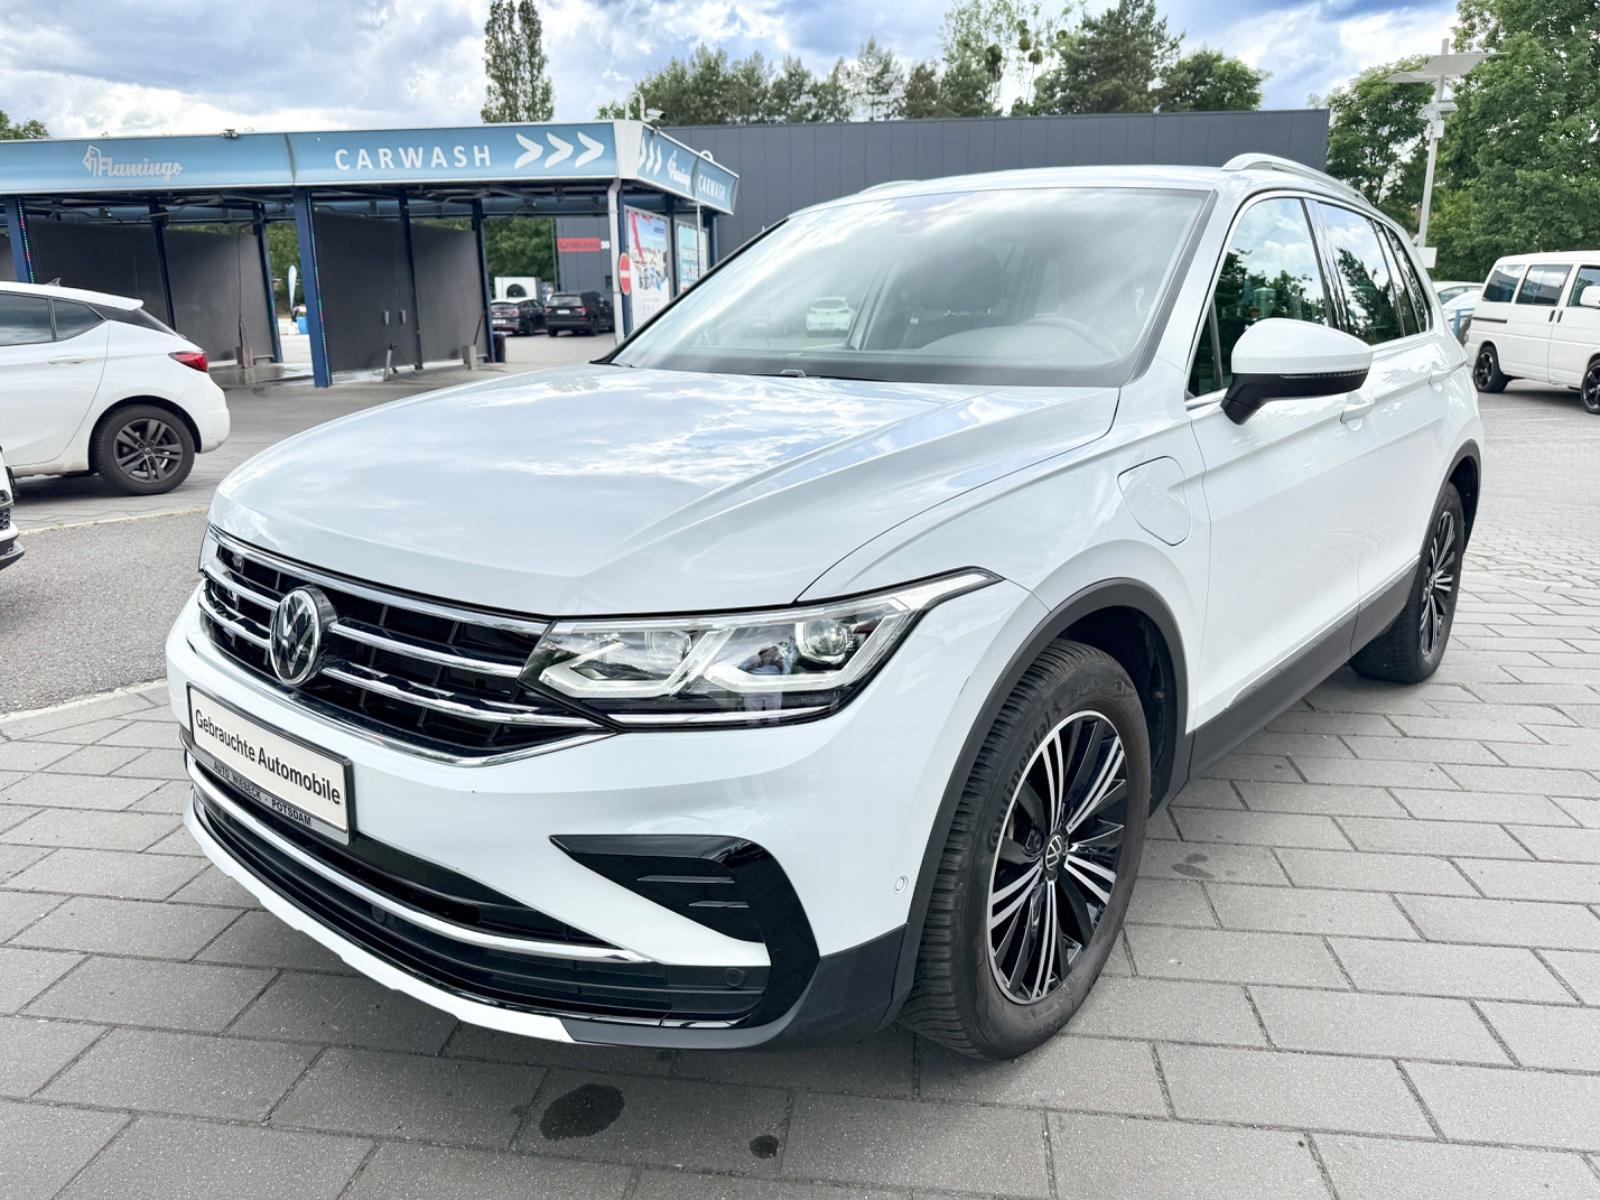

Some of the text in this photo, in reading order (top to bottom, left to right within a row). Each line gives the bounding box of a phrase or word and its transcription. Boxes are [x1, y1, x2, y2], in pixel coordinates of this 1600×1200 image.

[98, 157, 184, 182] Flamingo
[334, 145, 491, 171] CARWASH
[195, 708, 341, 805] Gebrauchte Automobile
[271, 799, 312, 827] POTSDAM
